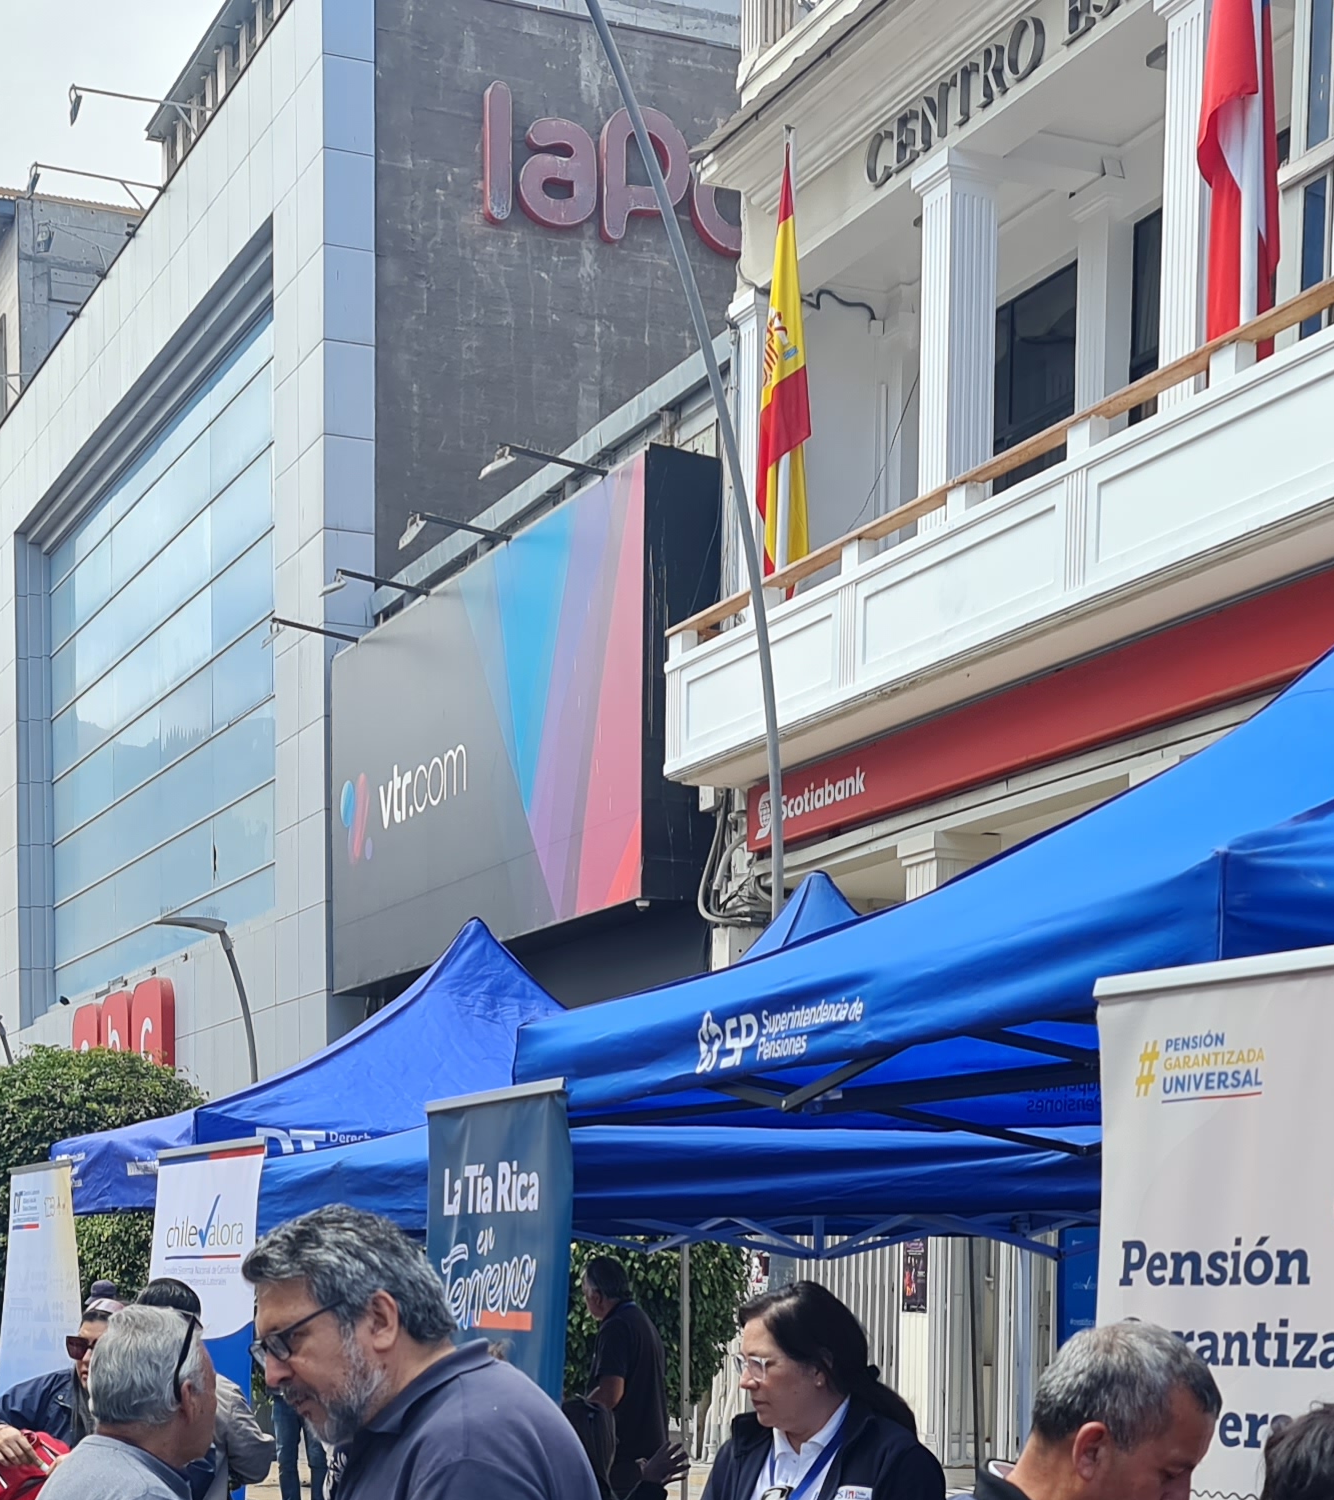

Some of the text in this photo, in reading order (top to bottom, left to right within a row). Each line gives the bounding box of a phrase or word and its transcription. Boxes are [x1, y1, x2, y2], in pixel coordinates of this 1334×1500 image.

[866, 16, 1046, 189] CENTRO
[379, 744, 467, 829] vtr.com
[761, 996, 864, 1037] Superintendencia de
[720, 1013, 759, 1069] SP
[756, 1034, 807, 1061] Pensiones
[1164, 1048, 1265, 1071] GARANTIZADA
[1165, 1030, 1225, 1052] PENSIÓN
[1162, 1068, 1263, 1094] UNIVERSAL
[443, 1160, 539, 1216] La Tía Rica
[476, 1226, 495, 1256] en
[1119, 1236, 1311, 1286] Pensión
[441, 1243, 536, 1330] Terreno
